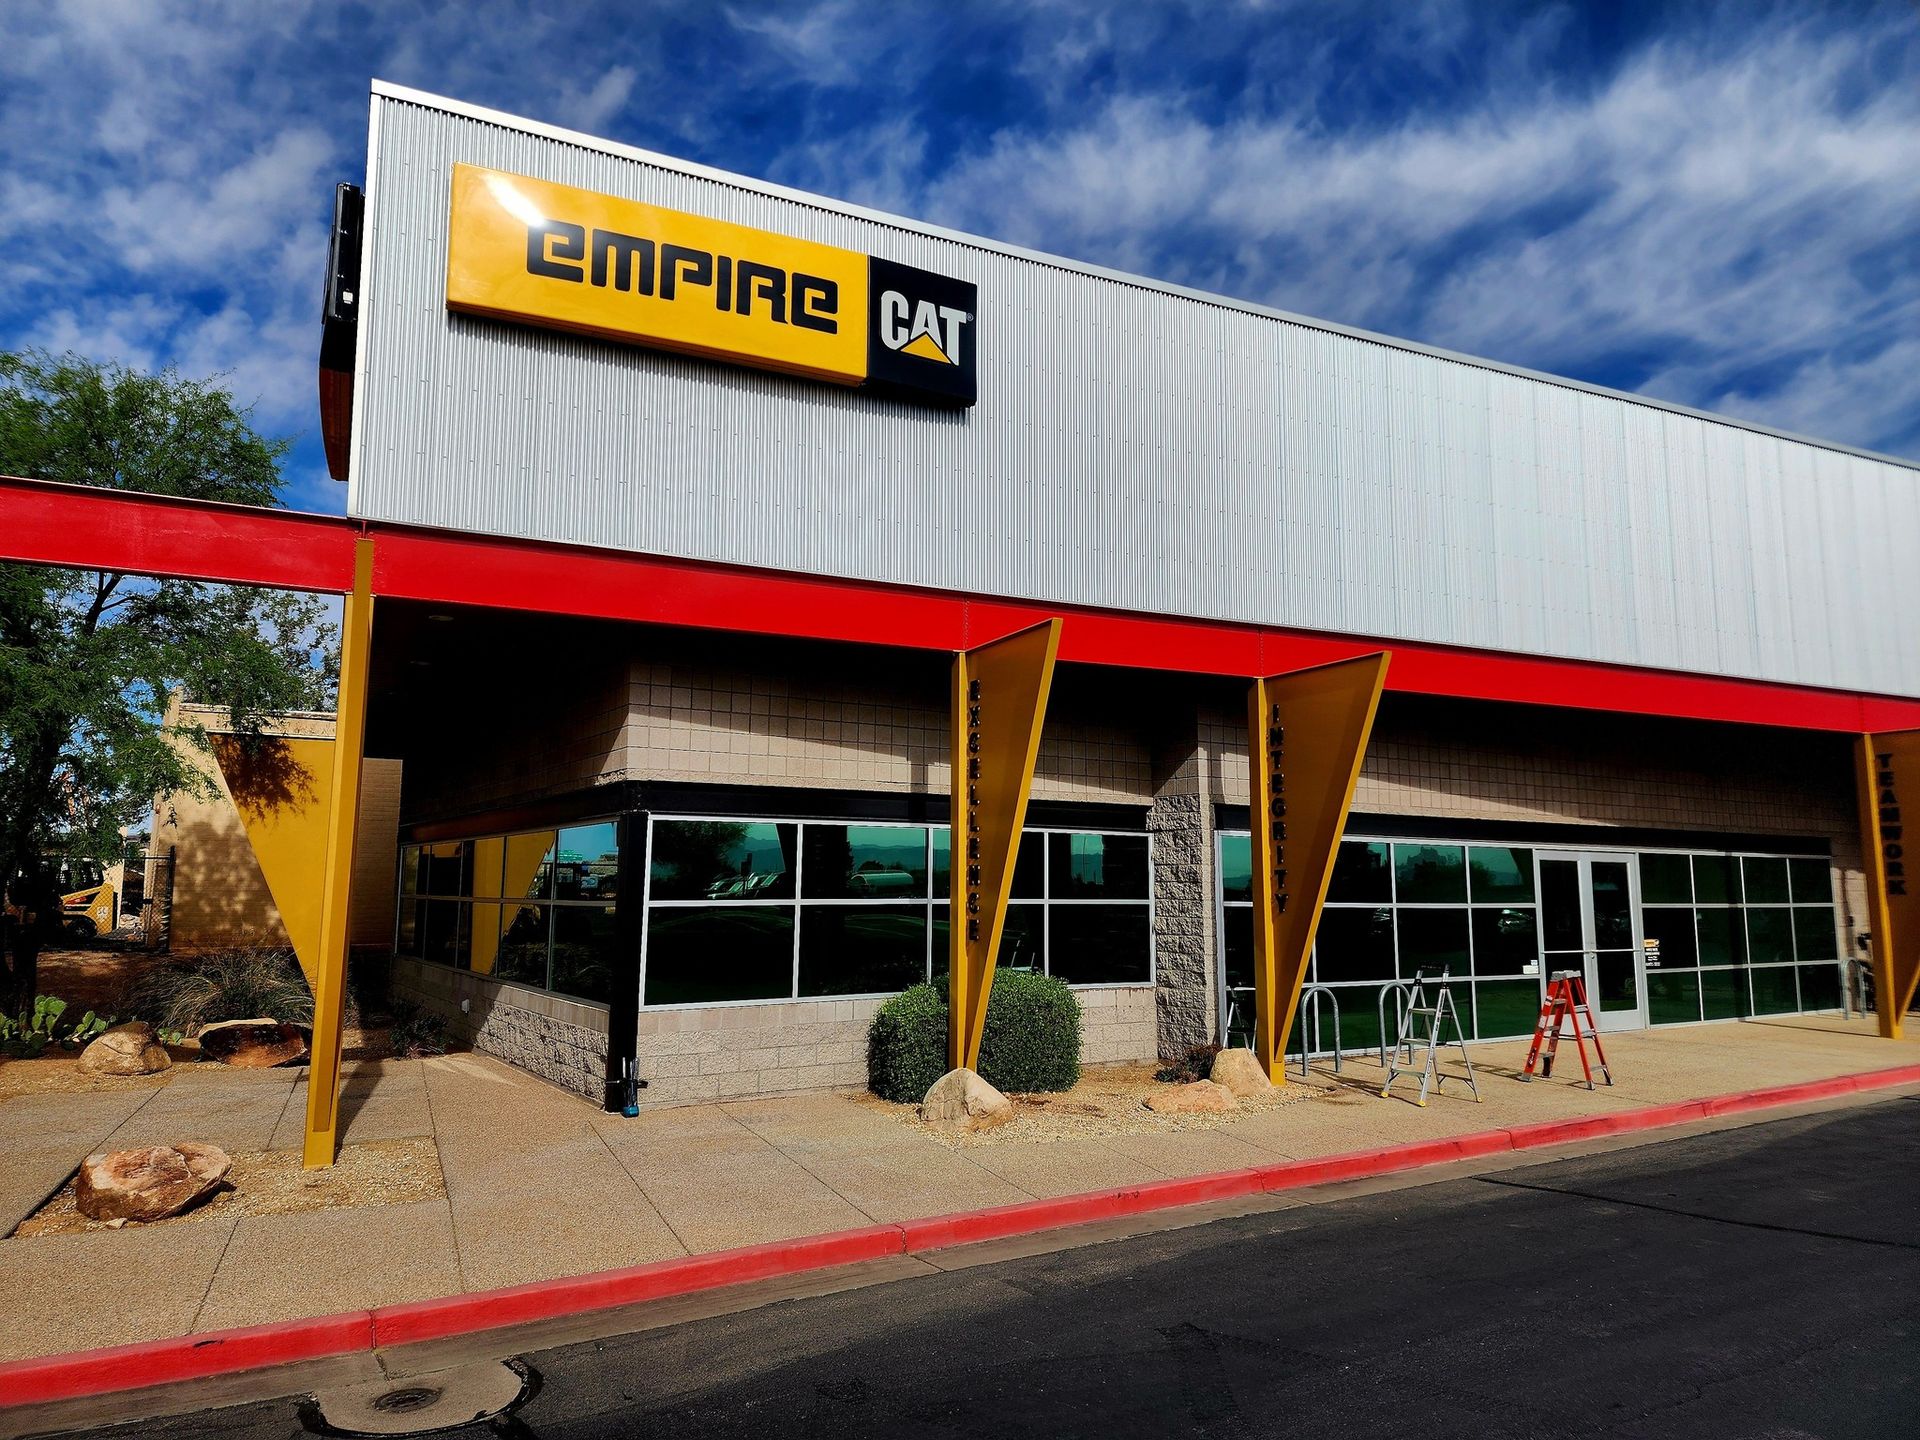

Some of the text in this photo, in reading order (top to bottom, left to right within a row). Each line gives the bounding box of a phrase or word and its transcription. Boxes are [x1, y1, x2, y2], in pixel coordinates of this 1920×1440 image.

[527, 221, 838, 335] EMPIRE
[968, 679, 981, 942] EXCELLENCE
[1269, 703, 1289, 914] INTEGRITY
[1877, 752, 1907, 895] TEAMWORK
